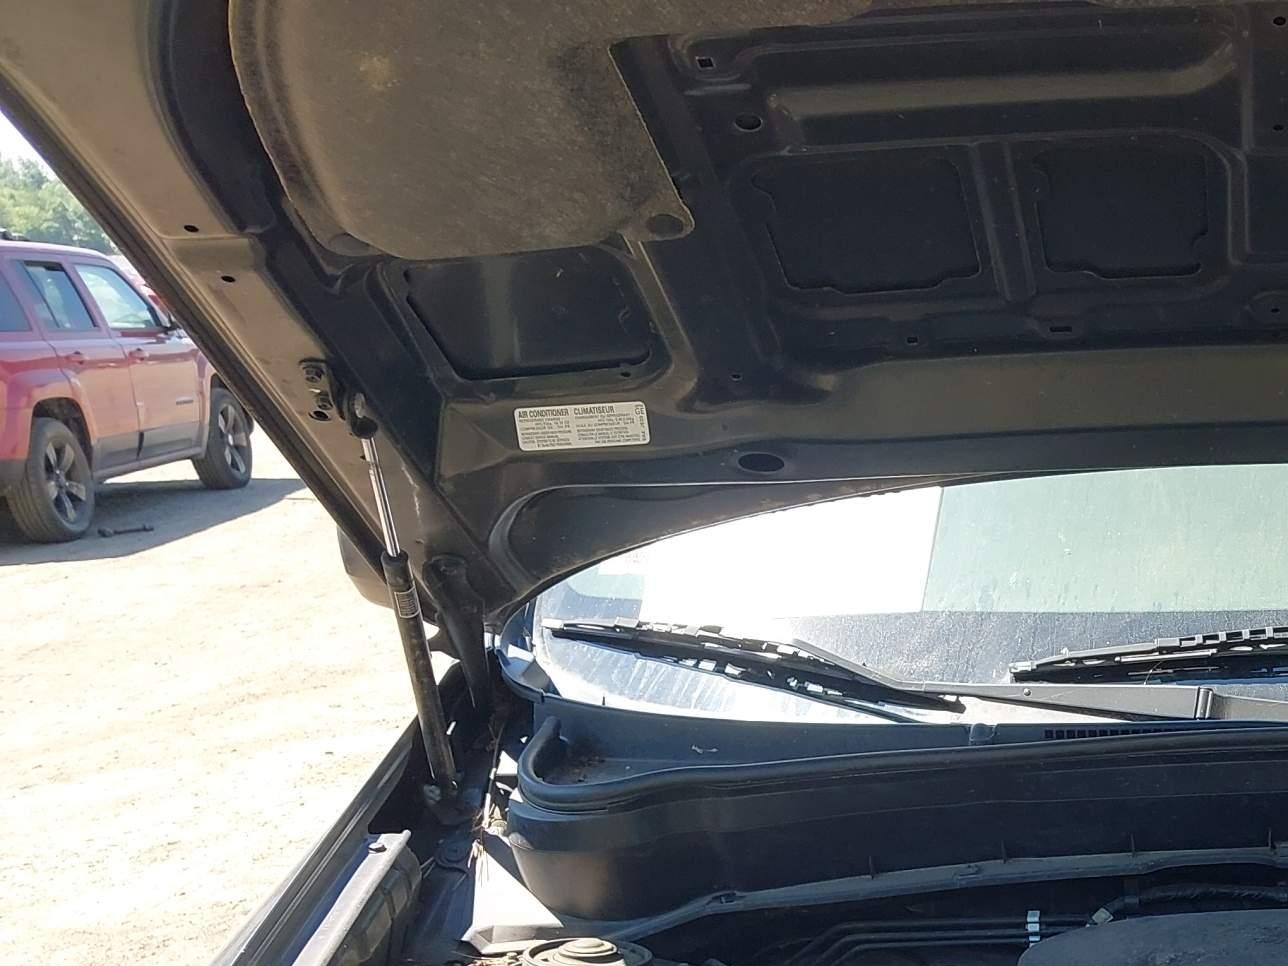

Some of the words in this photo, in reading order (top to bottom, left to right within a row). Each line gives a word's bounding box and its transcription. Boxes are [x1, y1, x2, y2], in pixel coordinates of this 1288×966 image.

[518, 410, 528, 419] AIR
[529, 408, 569, 418] CONDITIONER
[574, 405, 615, 415] CLIMATISEUR
[634, 407, 645, 415] GE
